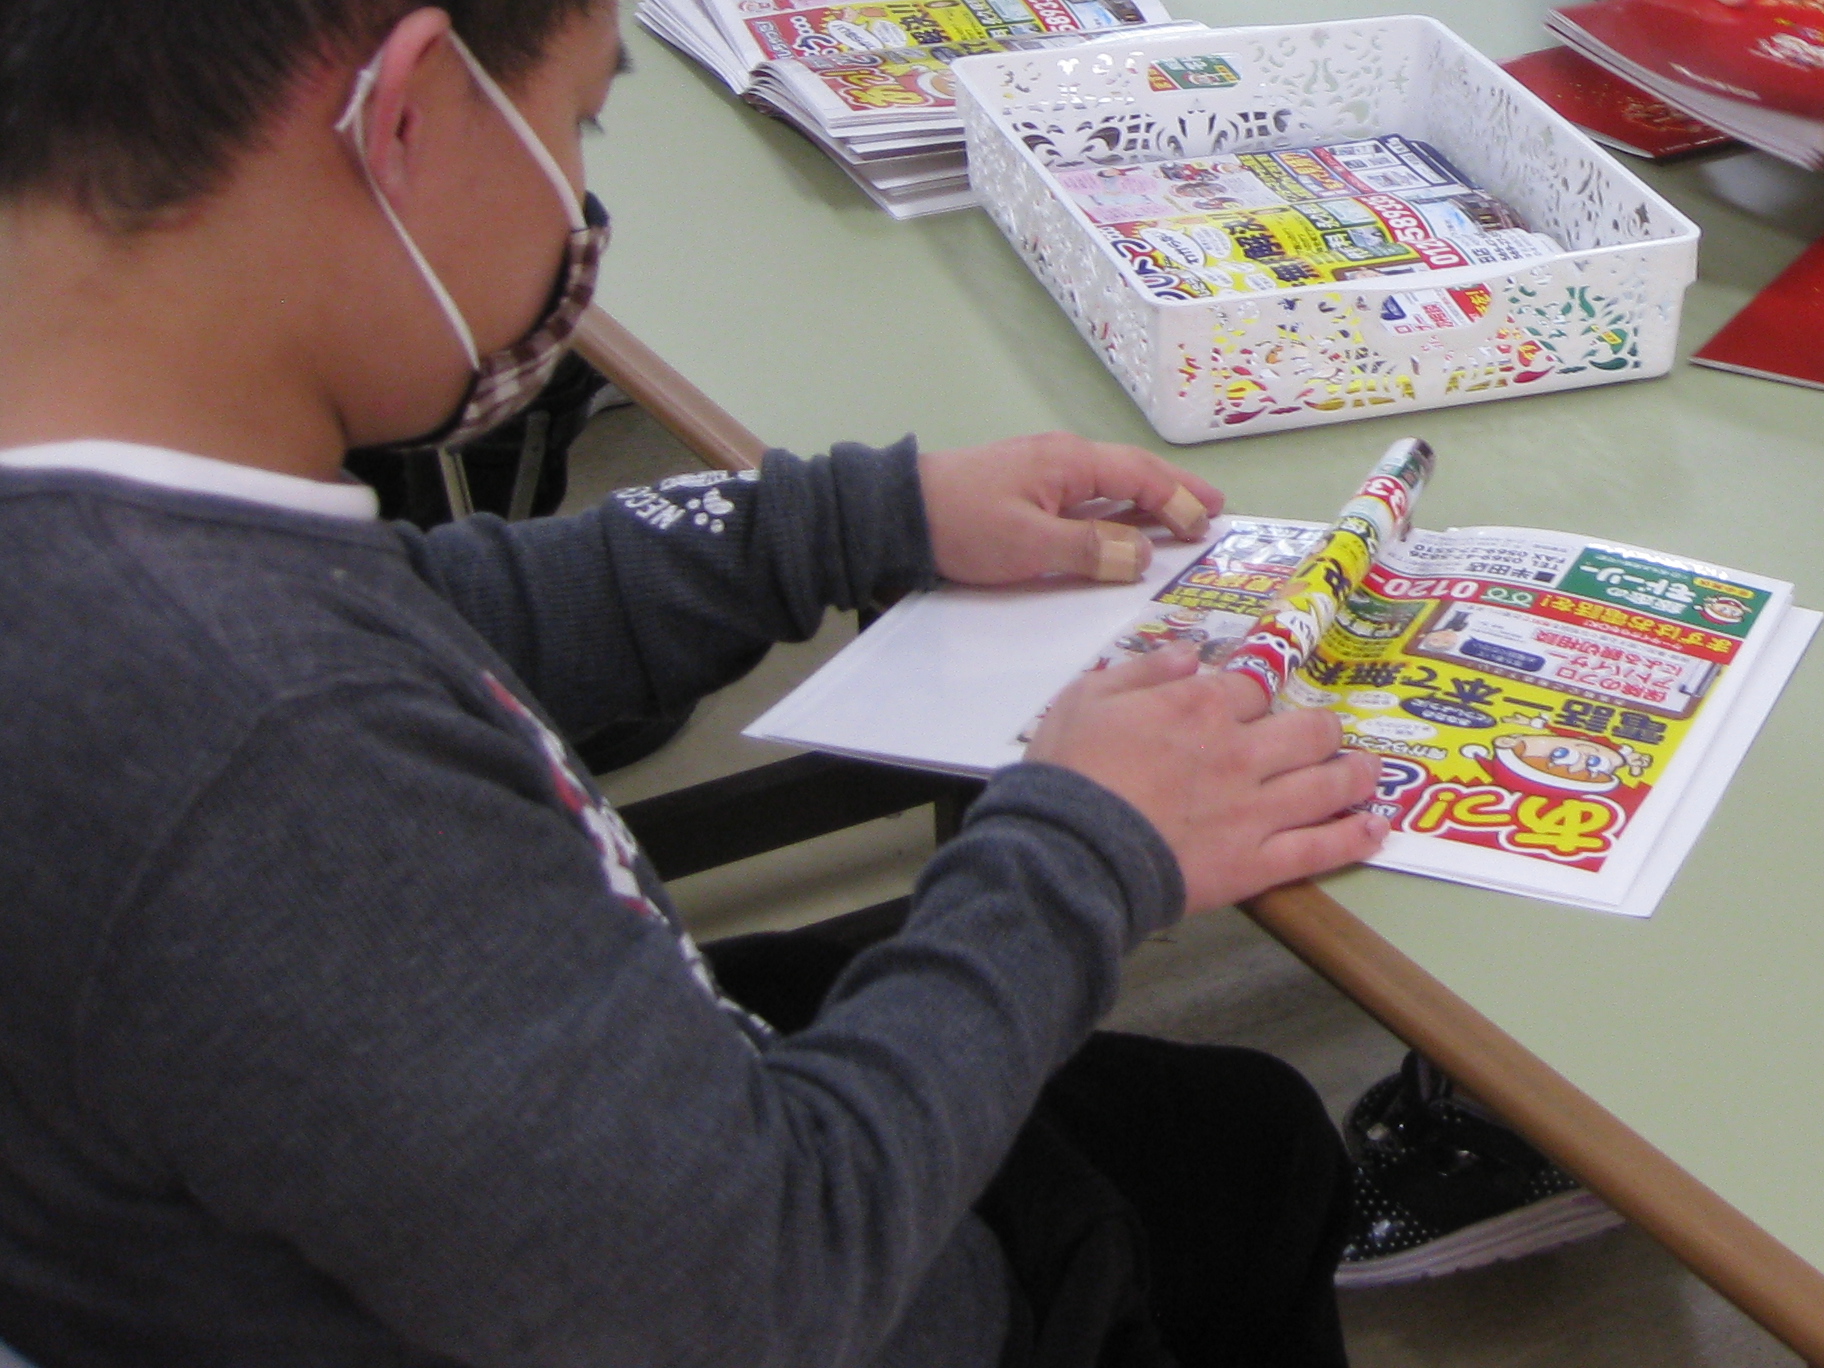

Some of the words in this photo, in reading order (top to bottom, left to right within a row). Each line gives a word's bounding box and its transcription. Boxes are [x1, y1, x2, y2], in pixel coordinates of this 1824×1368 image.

[1466, 561, 1534, 580] 半田店
[1577, 563, 1696, 603] モドーリー
[1536, 593, 1733, 653] まずはお電話を!
[1529, 628, 1684, 675] による親切相談
[1542, 651, 1675, 687] アドバイザー
[1551, 665, 1668, 702] 保険のプロ
[1413, 790, 1617, 853] あっ!
